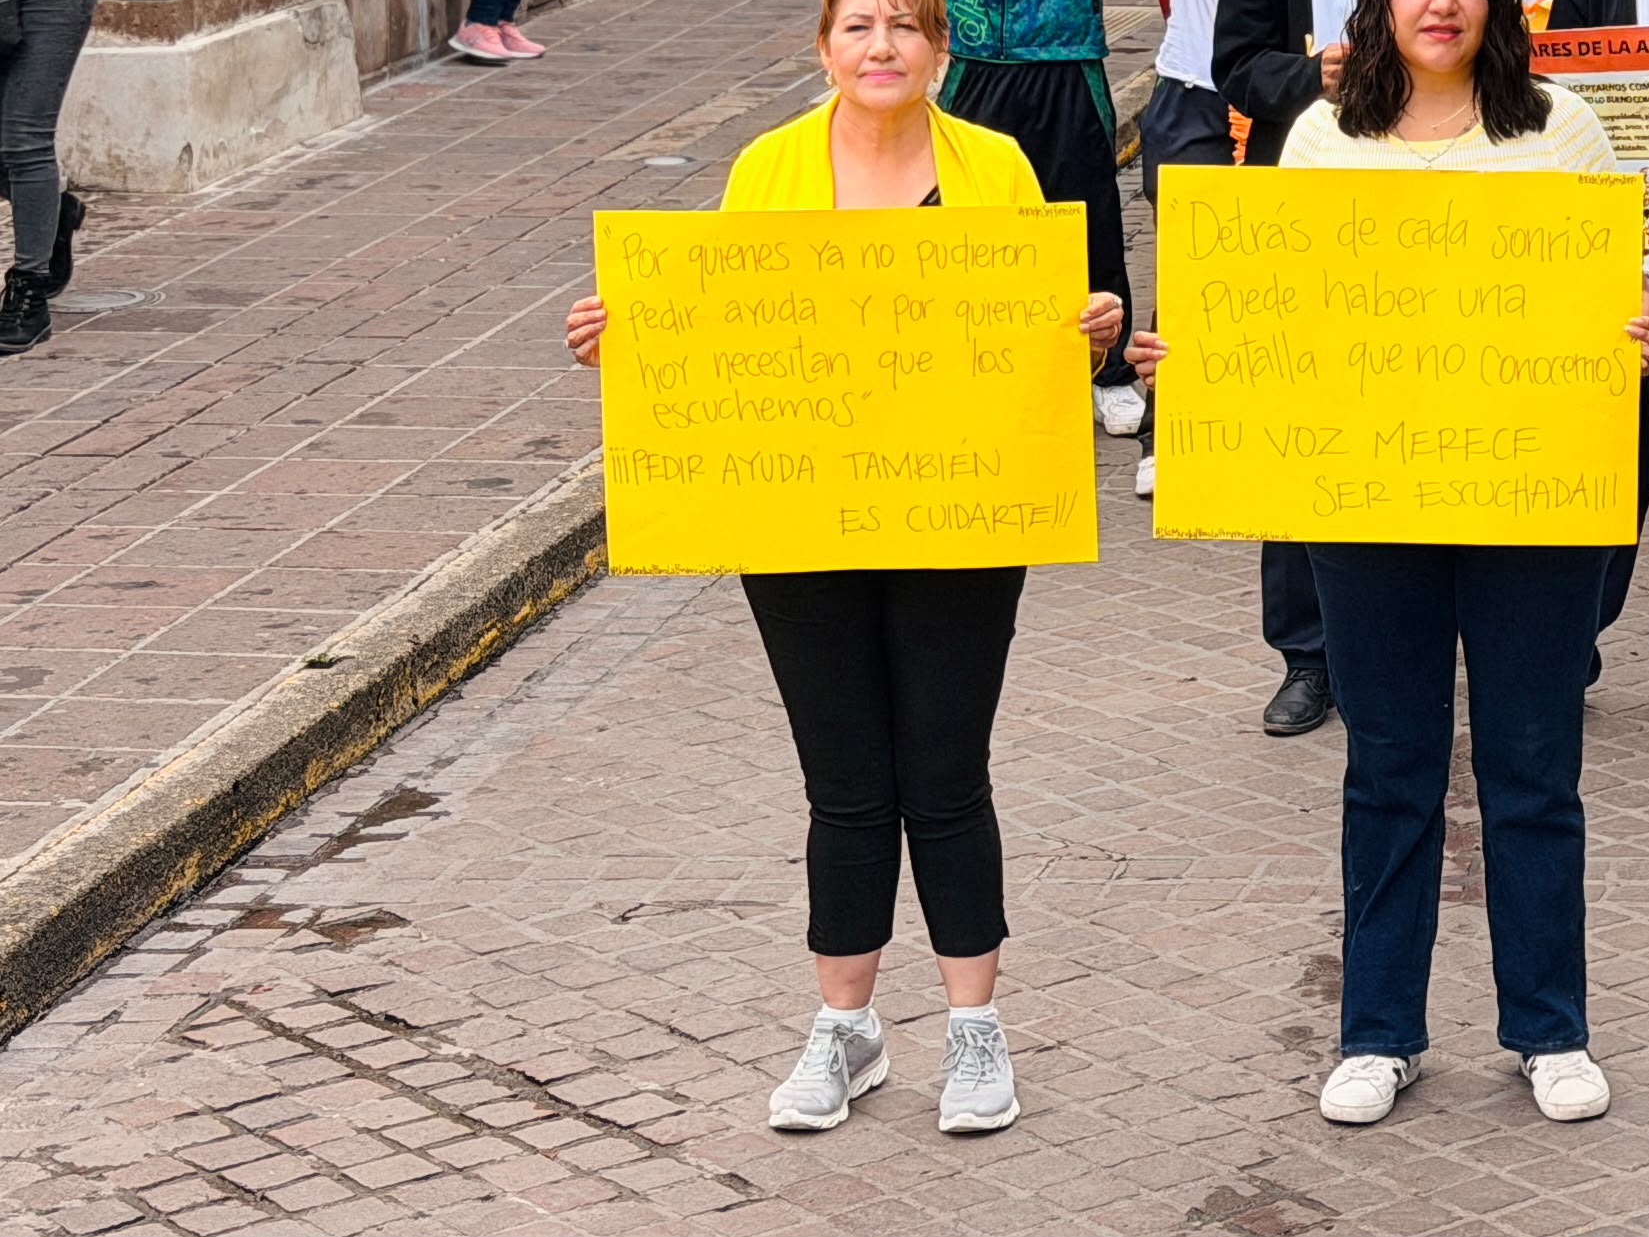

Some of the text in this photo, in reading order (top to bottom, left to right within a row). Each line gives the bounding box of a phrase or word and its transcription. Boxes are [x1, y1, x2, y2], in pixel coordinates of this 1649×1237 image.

[1578, 39, 1603, 57] DE
[1607, 38, 1631, 55] LA
[1337, 197, 1380, 259] de
[1398, 199, 1468, 259] cada
[1491, 216, 1610, 262] sonrisa
[688, 237, 790, 294] quienes
[861, 242, 895, 269] no
[917, 233, 1038, 280] pudieron
[627, 294, 698, 342] pedir
[894, 294, 934, 334] por
[955, 292, 1061, 344] quienes
[1201, 269, 1525, 332] puede haber una
[713, 336, 850, 384] necesitan
[878, 350, 934, 389] que
[971, 338, 1014, 376] los
[1198, 329, 1318, 388] batalla
[1347, 341, 1402, 397] que
[1416, 344, 1466, 381] no
[722, 453, 816, 485] AYUDA
[842, 438, 1000, 483] TAMBIÉN
[1264, 427, 1349, 459] VOZ
[1374, 420, 1542, 465] MERECE
[838, 505, 881, 536] ES
[1313, 476, 1393, 517] SER
